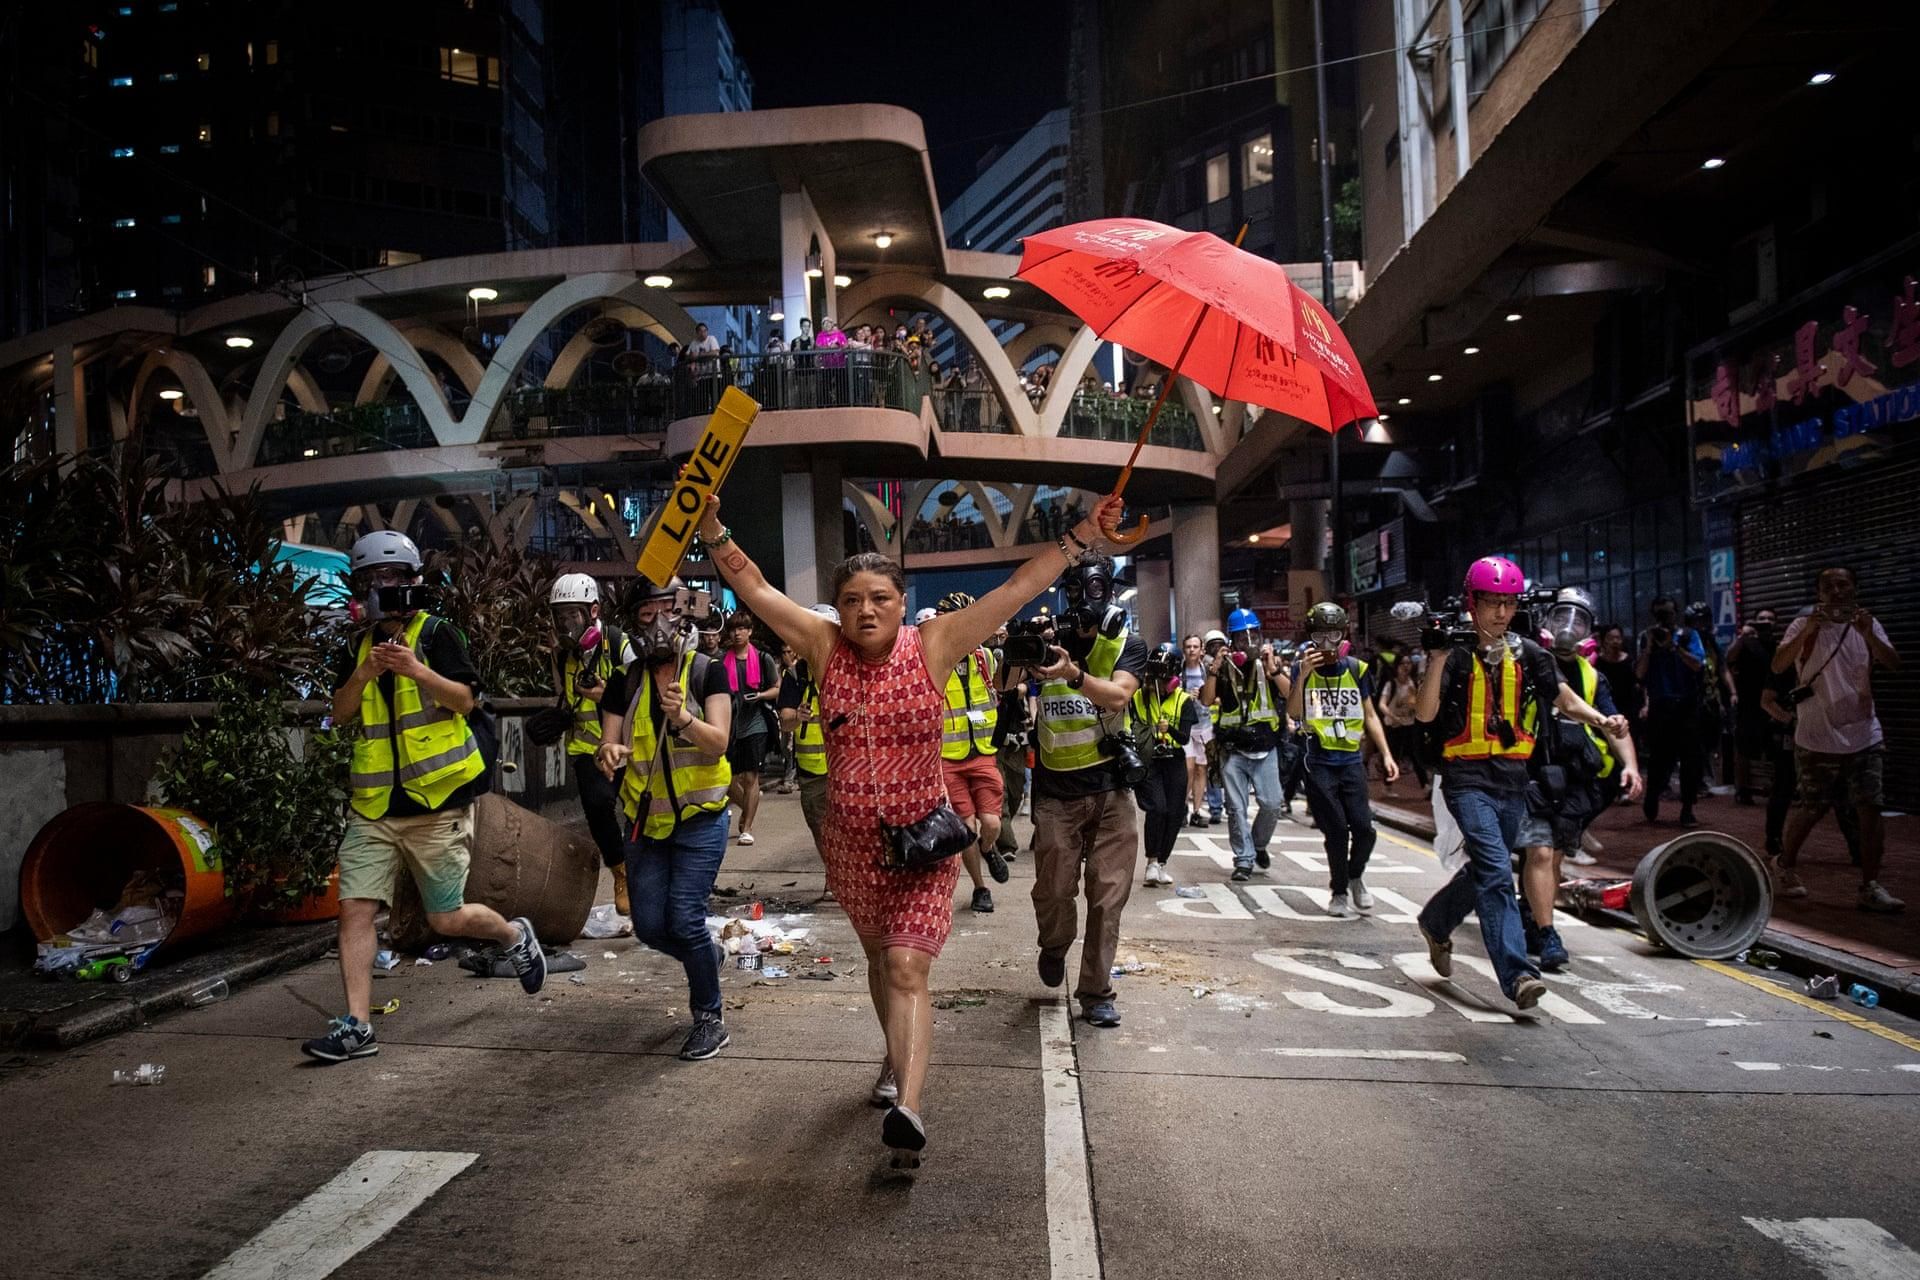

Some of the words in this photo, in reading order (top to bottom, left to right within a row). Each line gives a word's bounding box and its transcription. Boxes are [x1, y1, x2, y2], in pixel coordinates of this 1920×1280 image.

[662, 432, 730, 543] LOVE
[1310, 689, 1358, 706] PRESS
[1044, 700, 1083, 716] PRESS
